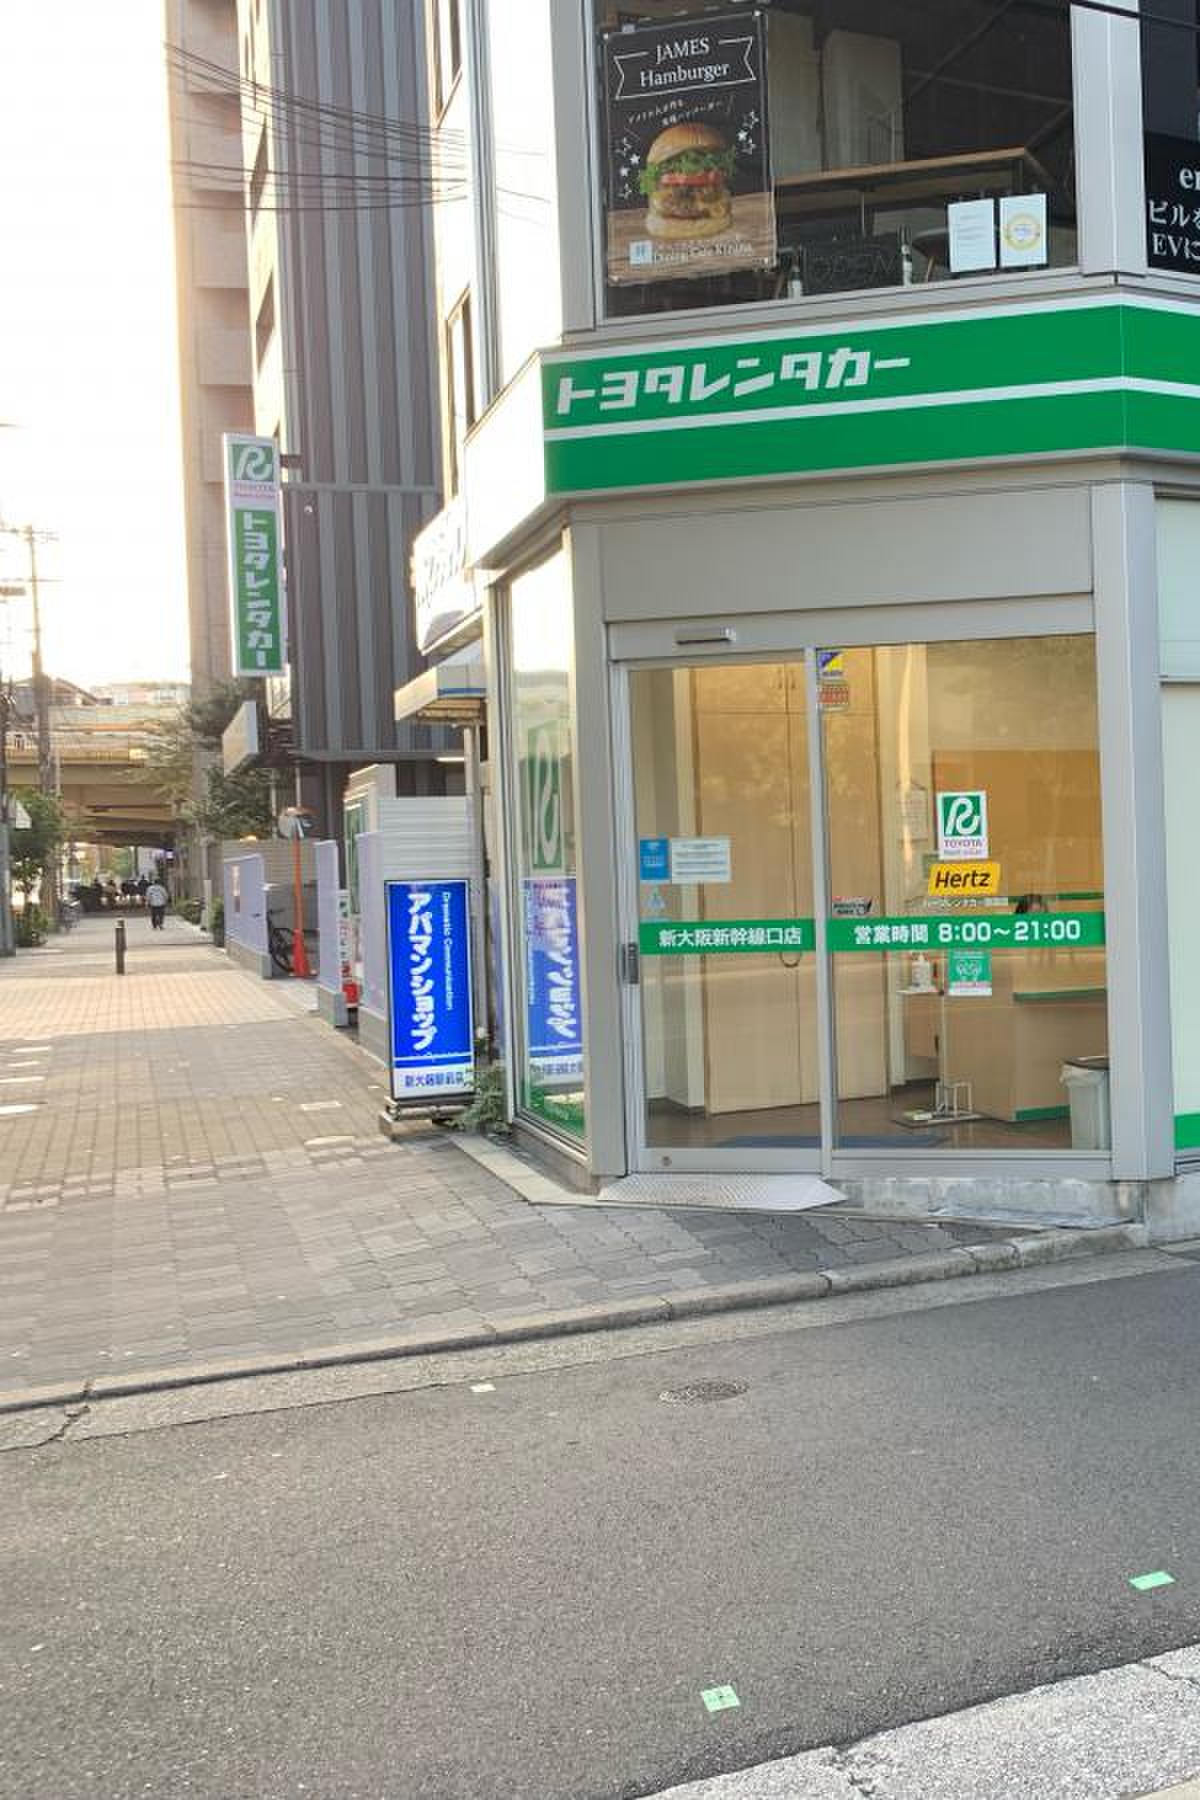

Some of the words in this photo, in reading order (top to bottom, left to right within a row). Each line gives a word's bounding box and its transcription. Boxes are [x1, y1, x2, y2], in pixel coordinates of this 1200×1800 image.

[656, 37, 709, 64] JAMES
[640, 63, 729, 88] Hamburger
[557, 346, 911, 416] トヨタレンタカー
[243, 511, 273, 668] トヨタレンタカー
[935, 870, 991, 889] Hertz
[658, 925, 801, 947] 新大阪新幹線口店
[854, 923, 929, 945] 営業時間
[408, 892, 437, 1050] アパマンショップ
